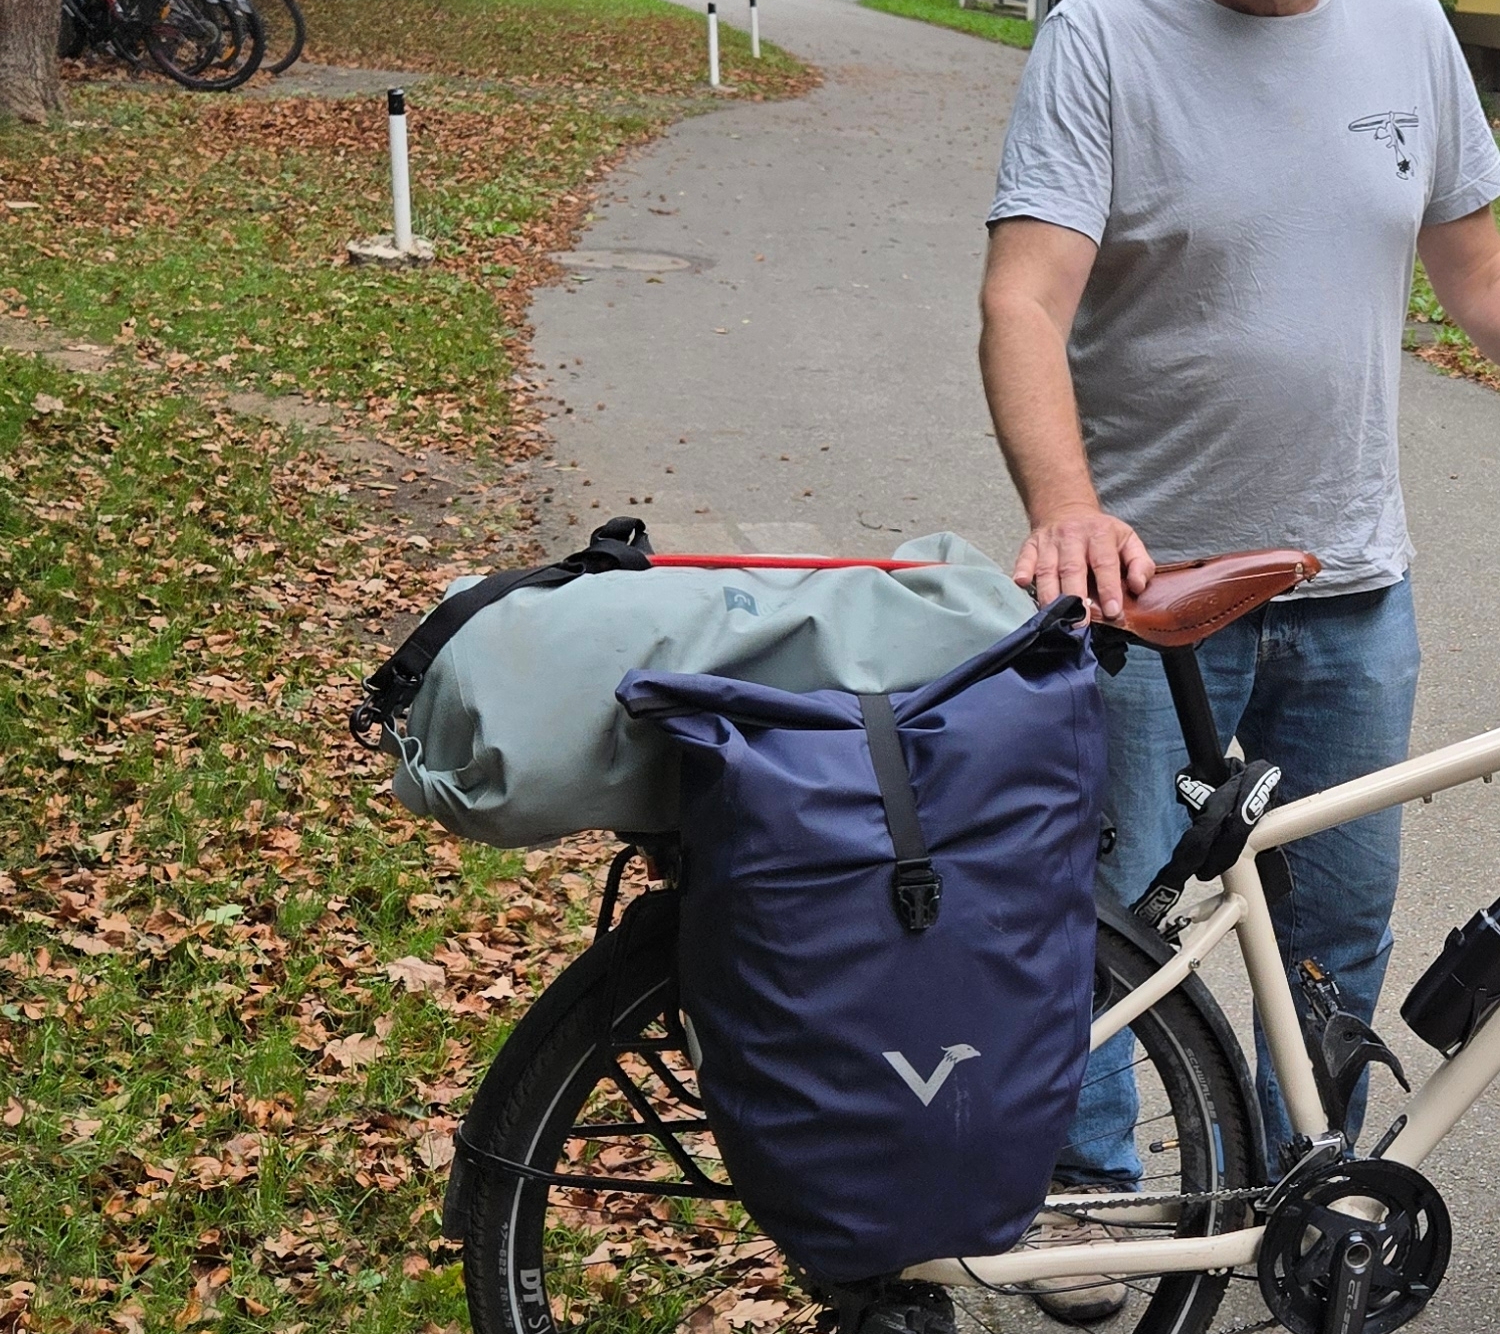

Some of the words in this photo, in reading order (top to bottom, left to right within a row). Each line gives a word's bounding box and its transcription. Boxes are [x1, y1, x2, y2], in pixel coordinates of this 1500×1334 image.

[1178, 779, 1212, 806] US
[1184, 1047, 1218, 1119] SCHWALBE
[520, 1268, 545, 1307] DT
